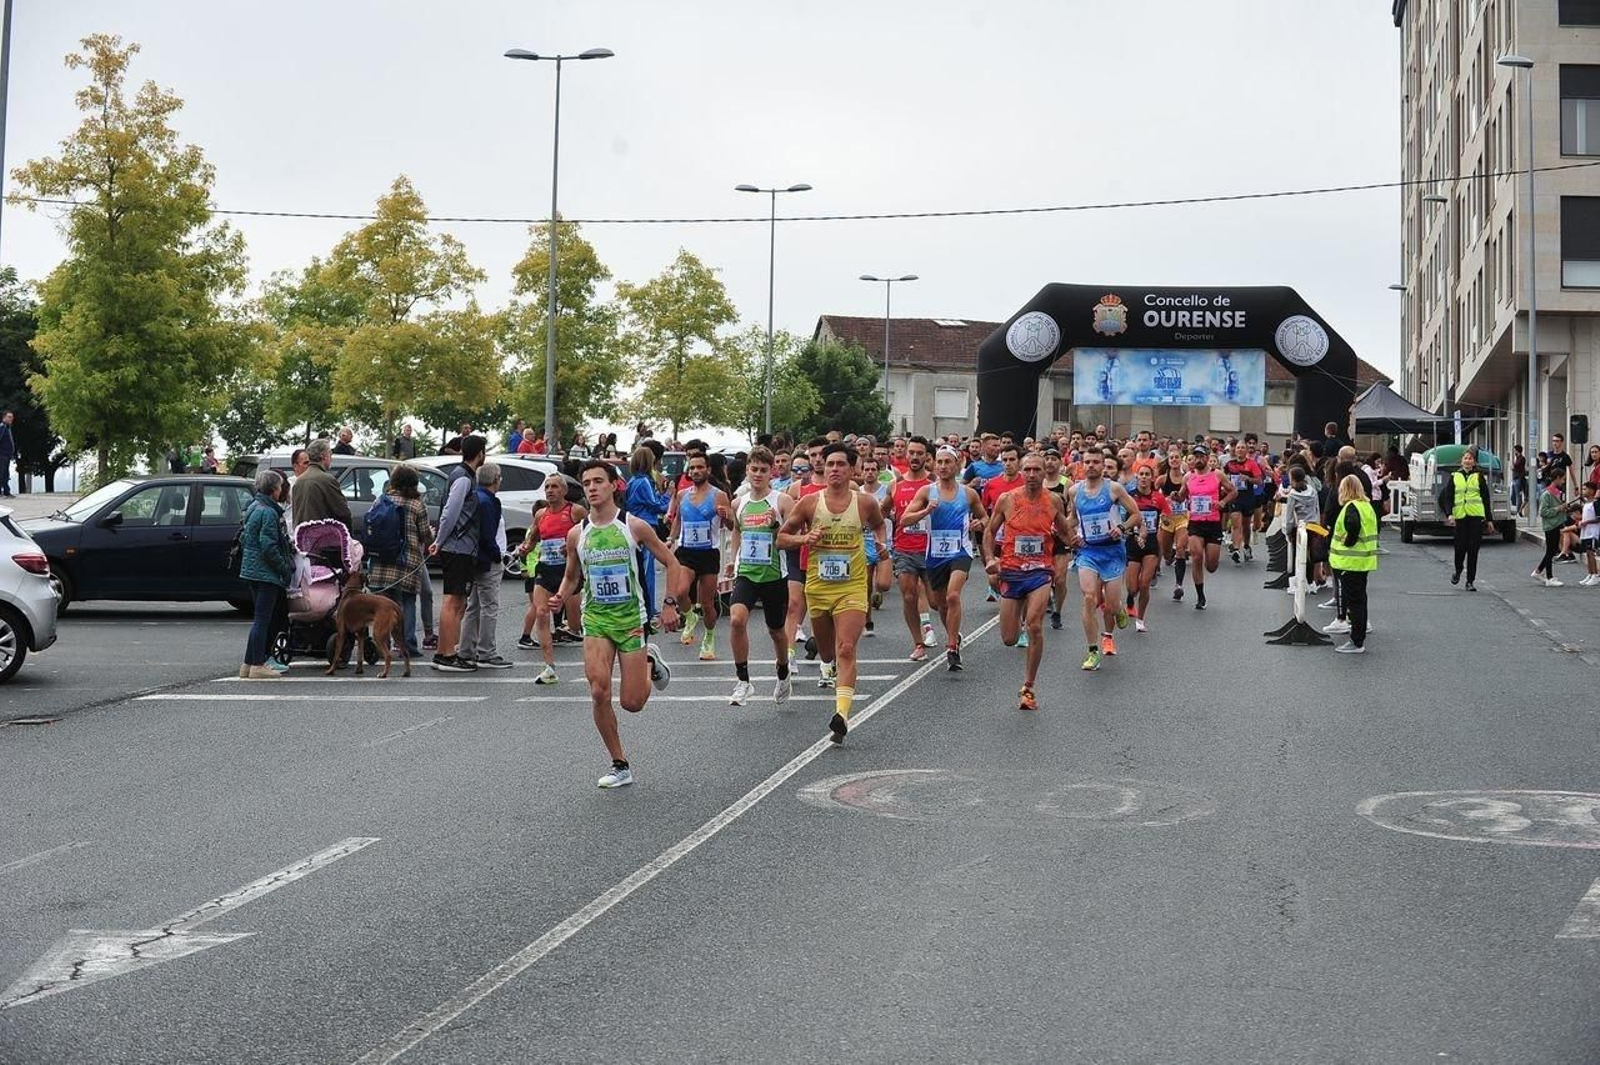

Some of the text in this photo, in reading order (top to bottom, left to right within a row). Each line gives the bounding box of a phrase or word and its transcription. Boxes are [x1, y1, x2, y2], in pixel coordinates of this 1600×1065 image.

[1144, 294, 1231, 306] Concello de
[1143, 310, 1246, 328] OURENSE
[1174, 332, 1214, 341] Deportes
[1091, 524, 1102, 535] 32
[693, 533, 698, 542] 3
[750, 546, 756, 558] 2
[940, 542, 950, 552] 22
[825, 566, 840, 575] 709
[597, 582, 619, 596] 508
